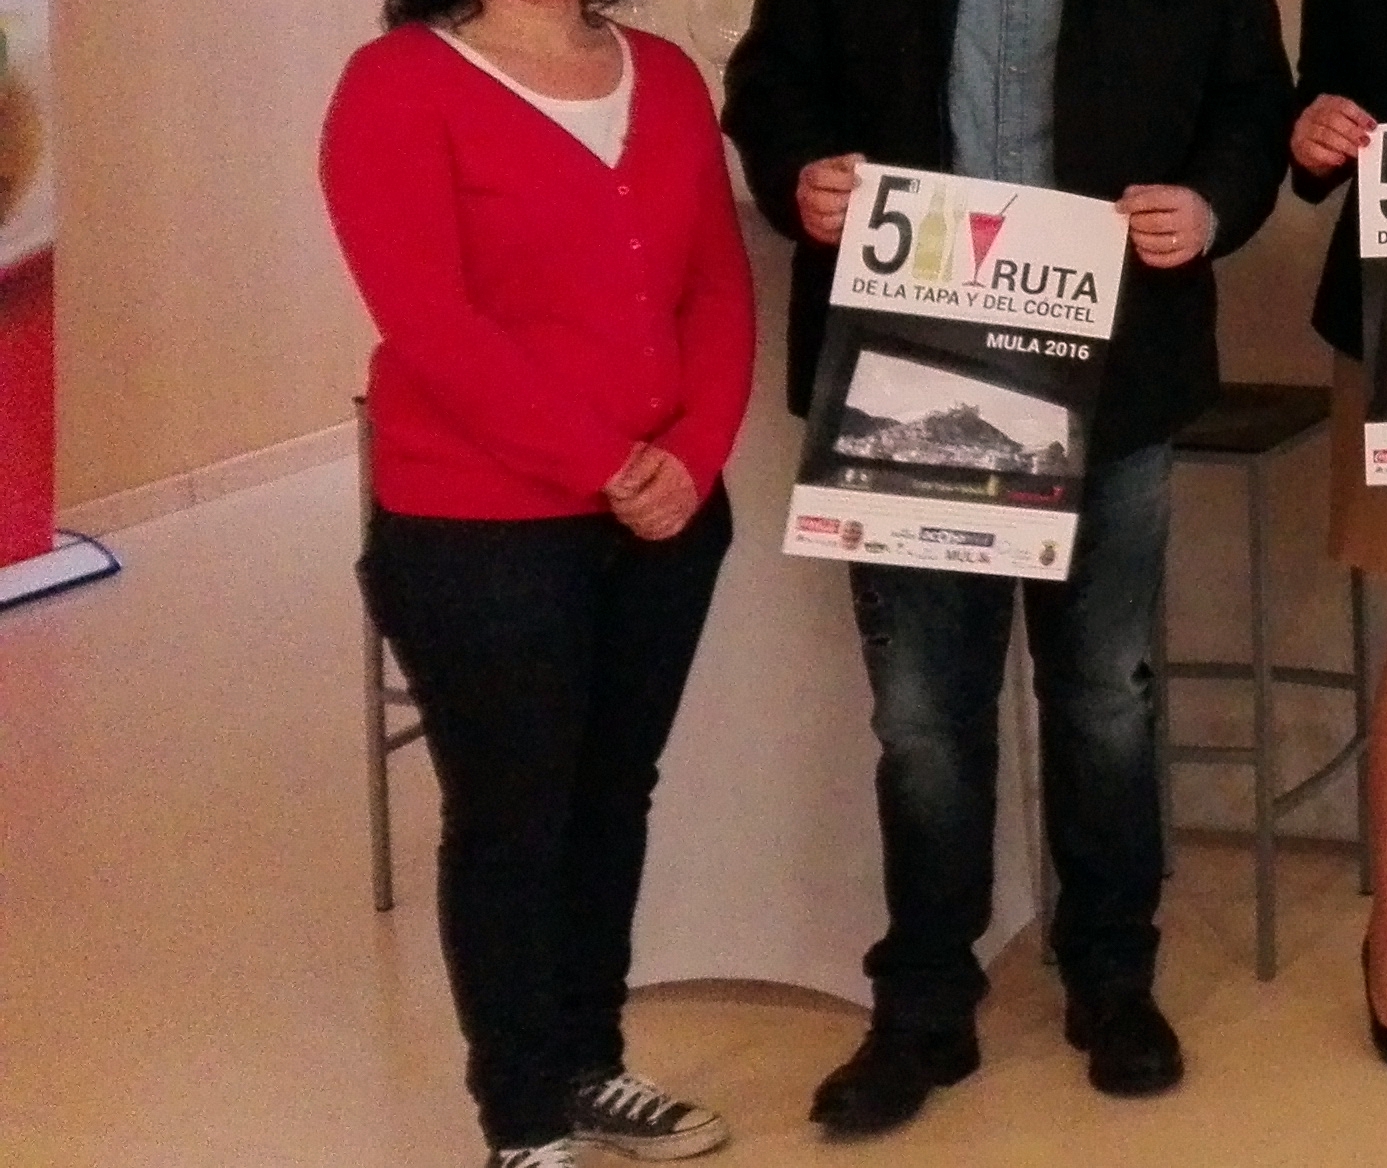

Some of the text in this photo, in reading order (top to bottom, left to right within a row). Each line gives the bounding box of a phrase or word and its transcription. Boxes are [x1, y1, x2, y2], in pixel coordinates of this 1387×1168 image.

[852, 277, 1095, 323] DE LA TAPA Y DEL CÓCTEL
[991, 258, 1099, 304] RUTA
[986, 331, 1090, 361] MULA 2016
